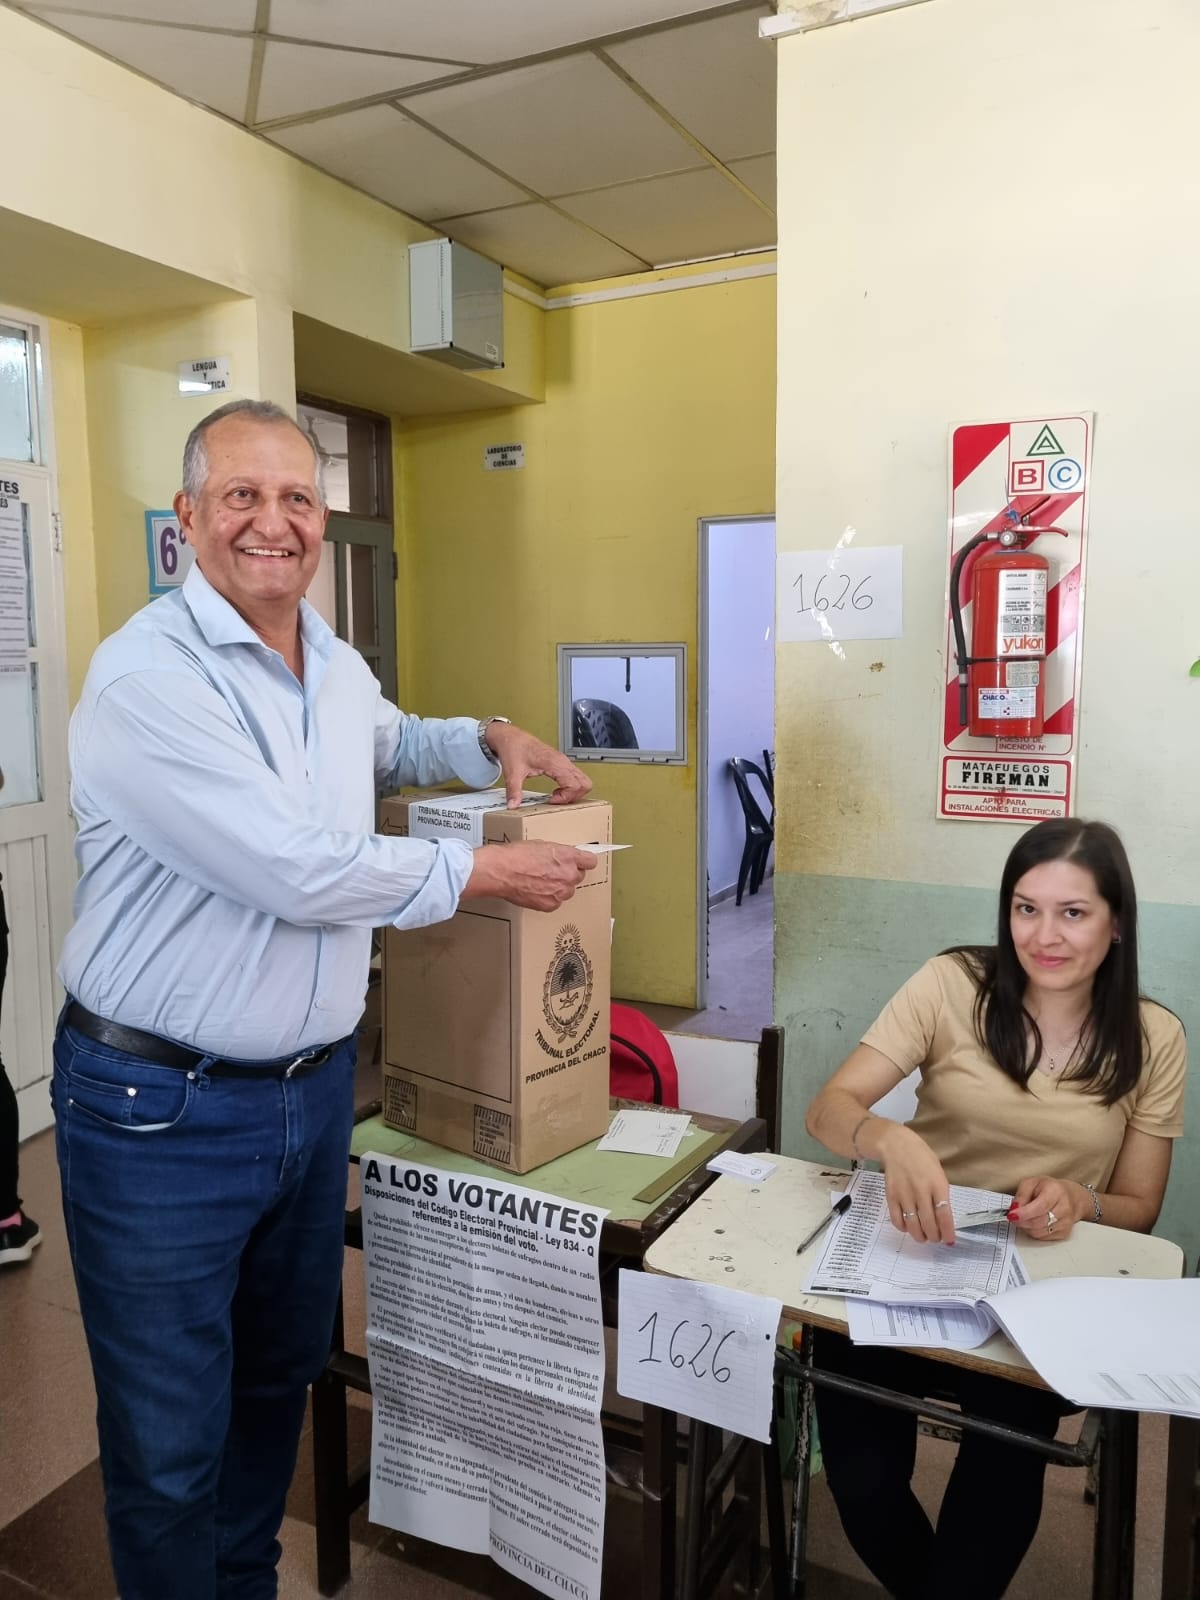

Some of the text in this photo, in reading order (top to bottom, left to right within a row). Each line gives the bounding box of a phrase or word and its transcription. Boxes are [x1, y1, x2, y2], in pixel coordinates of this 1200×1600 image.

[192, 360, 217, 372] LENGUA
[1037, 436, 1055, 450] A
[1018, 466, 1073, 485] B C
[793, 574, 873, 613] 1626
[1002, 634, 1044, 653] yukon
[999, 743, 1036, 751] INCENDIO
[962, 762, 1050, 774] MATAFUEGOS
[962, 771, 1050, 787] FIREMAN
[948, 803, 1062, 816] INSTALACIONES ELECTRICAS
[1006, 798, 1027, 806] PARA
[418, 805, 471, 820] TRIBUNAL ELECTORAL
[417, 816, 442, 826] PROVINCIA
[453, 821, 472, 831] CHACO
[534, 1010, 600, 1059] TRIBUNAL ELECTORAL
[526, 1046, 607, 1084] PROVINCIA DEL CHACO
[365, 1160, 598, 1239] A LOS VOTANTES
[364, 1185, 415, 1206] Disposiciones
[417, 1199, 429, 1211] del
[431, 1201, 458, 1218] Código
[460, 1209, 496, 1228] Electoral
[498, 1220, 539, 1241] Provincial
[545, 1234, 561, 1251] Ley
[563, 1239, 579, 1253] 834
[587, 1245, 595, 1257] Q
[412, 1209, 452, 1228] referentes
[461, 1222, 468, 1233] la
[470, 1226, 502, 1242] emisión
[504, 1234, 516, 1246] del
[518, 1239, 539, 1253] voto.
[638, 1312, 735, 1383] 1626
[534, 1564, 553, 1582] DEL
